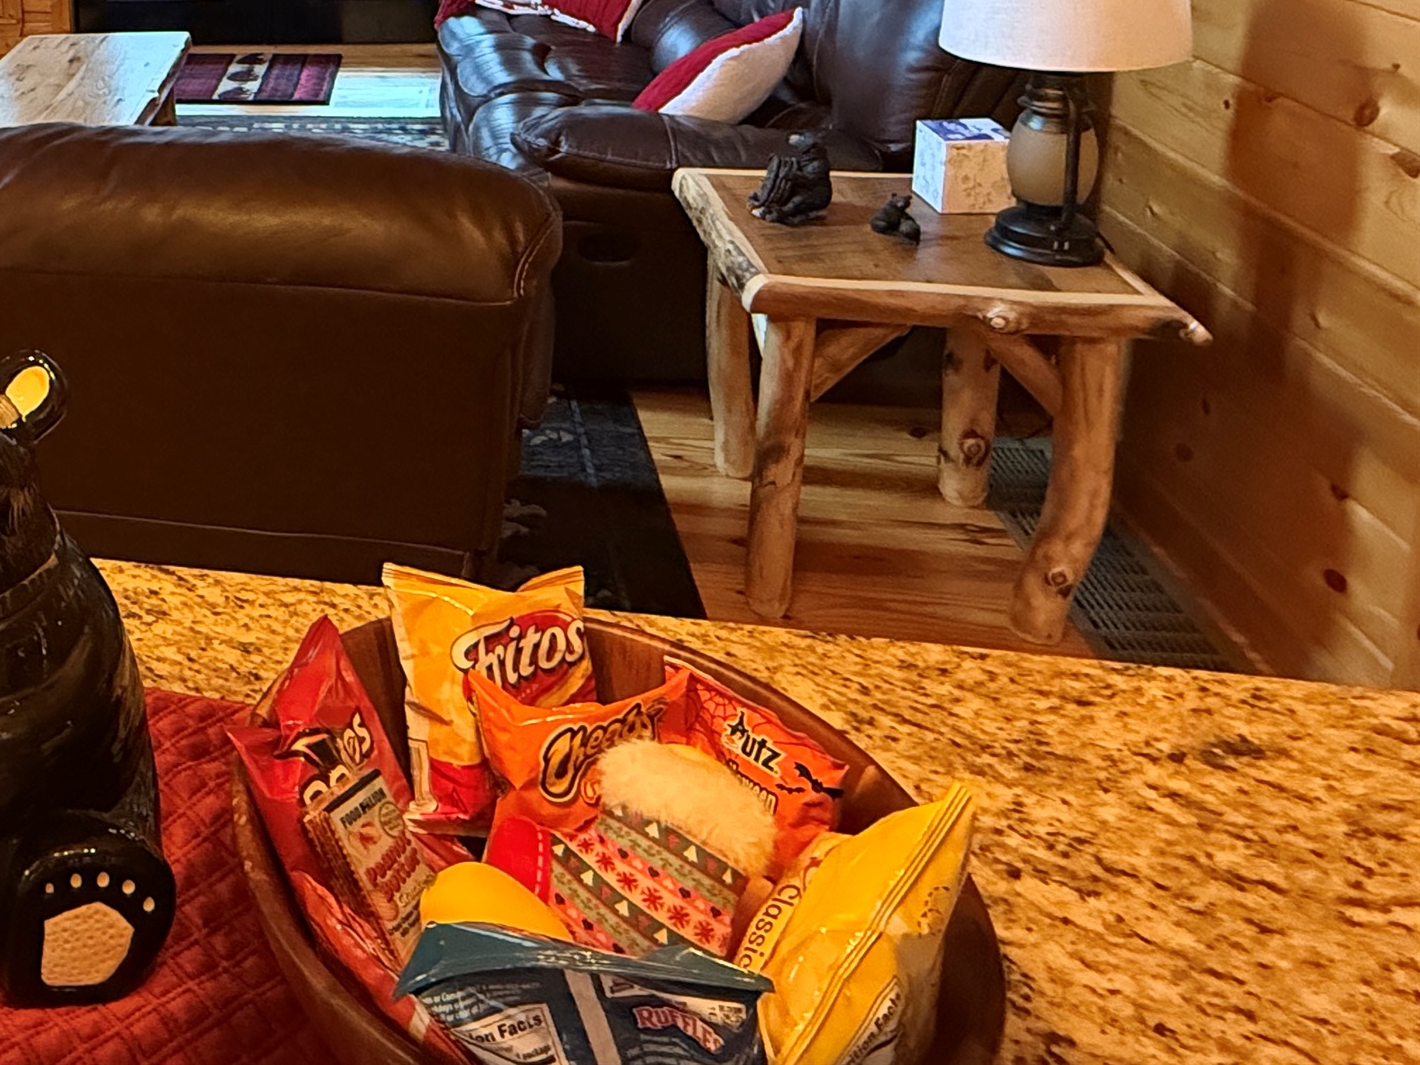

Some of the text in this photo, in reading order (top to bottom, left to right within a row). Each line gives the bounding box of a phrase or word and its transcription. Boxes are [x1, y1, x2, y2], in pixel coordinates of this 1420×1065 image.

[451, 617, 584, 687] Fritos
[340, 805, 362, 829] FOOD
[740, 883, 802, 969] Classic
[497, 1013, 543, 1039] Facts
[633, 1006, 725, 1053] RUFFLES
